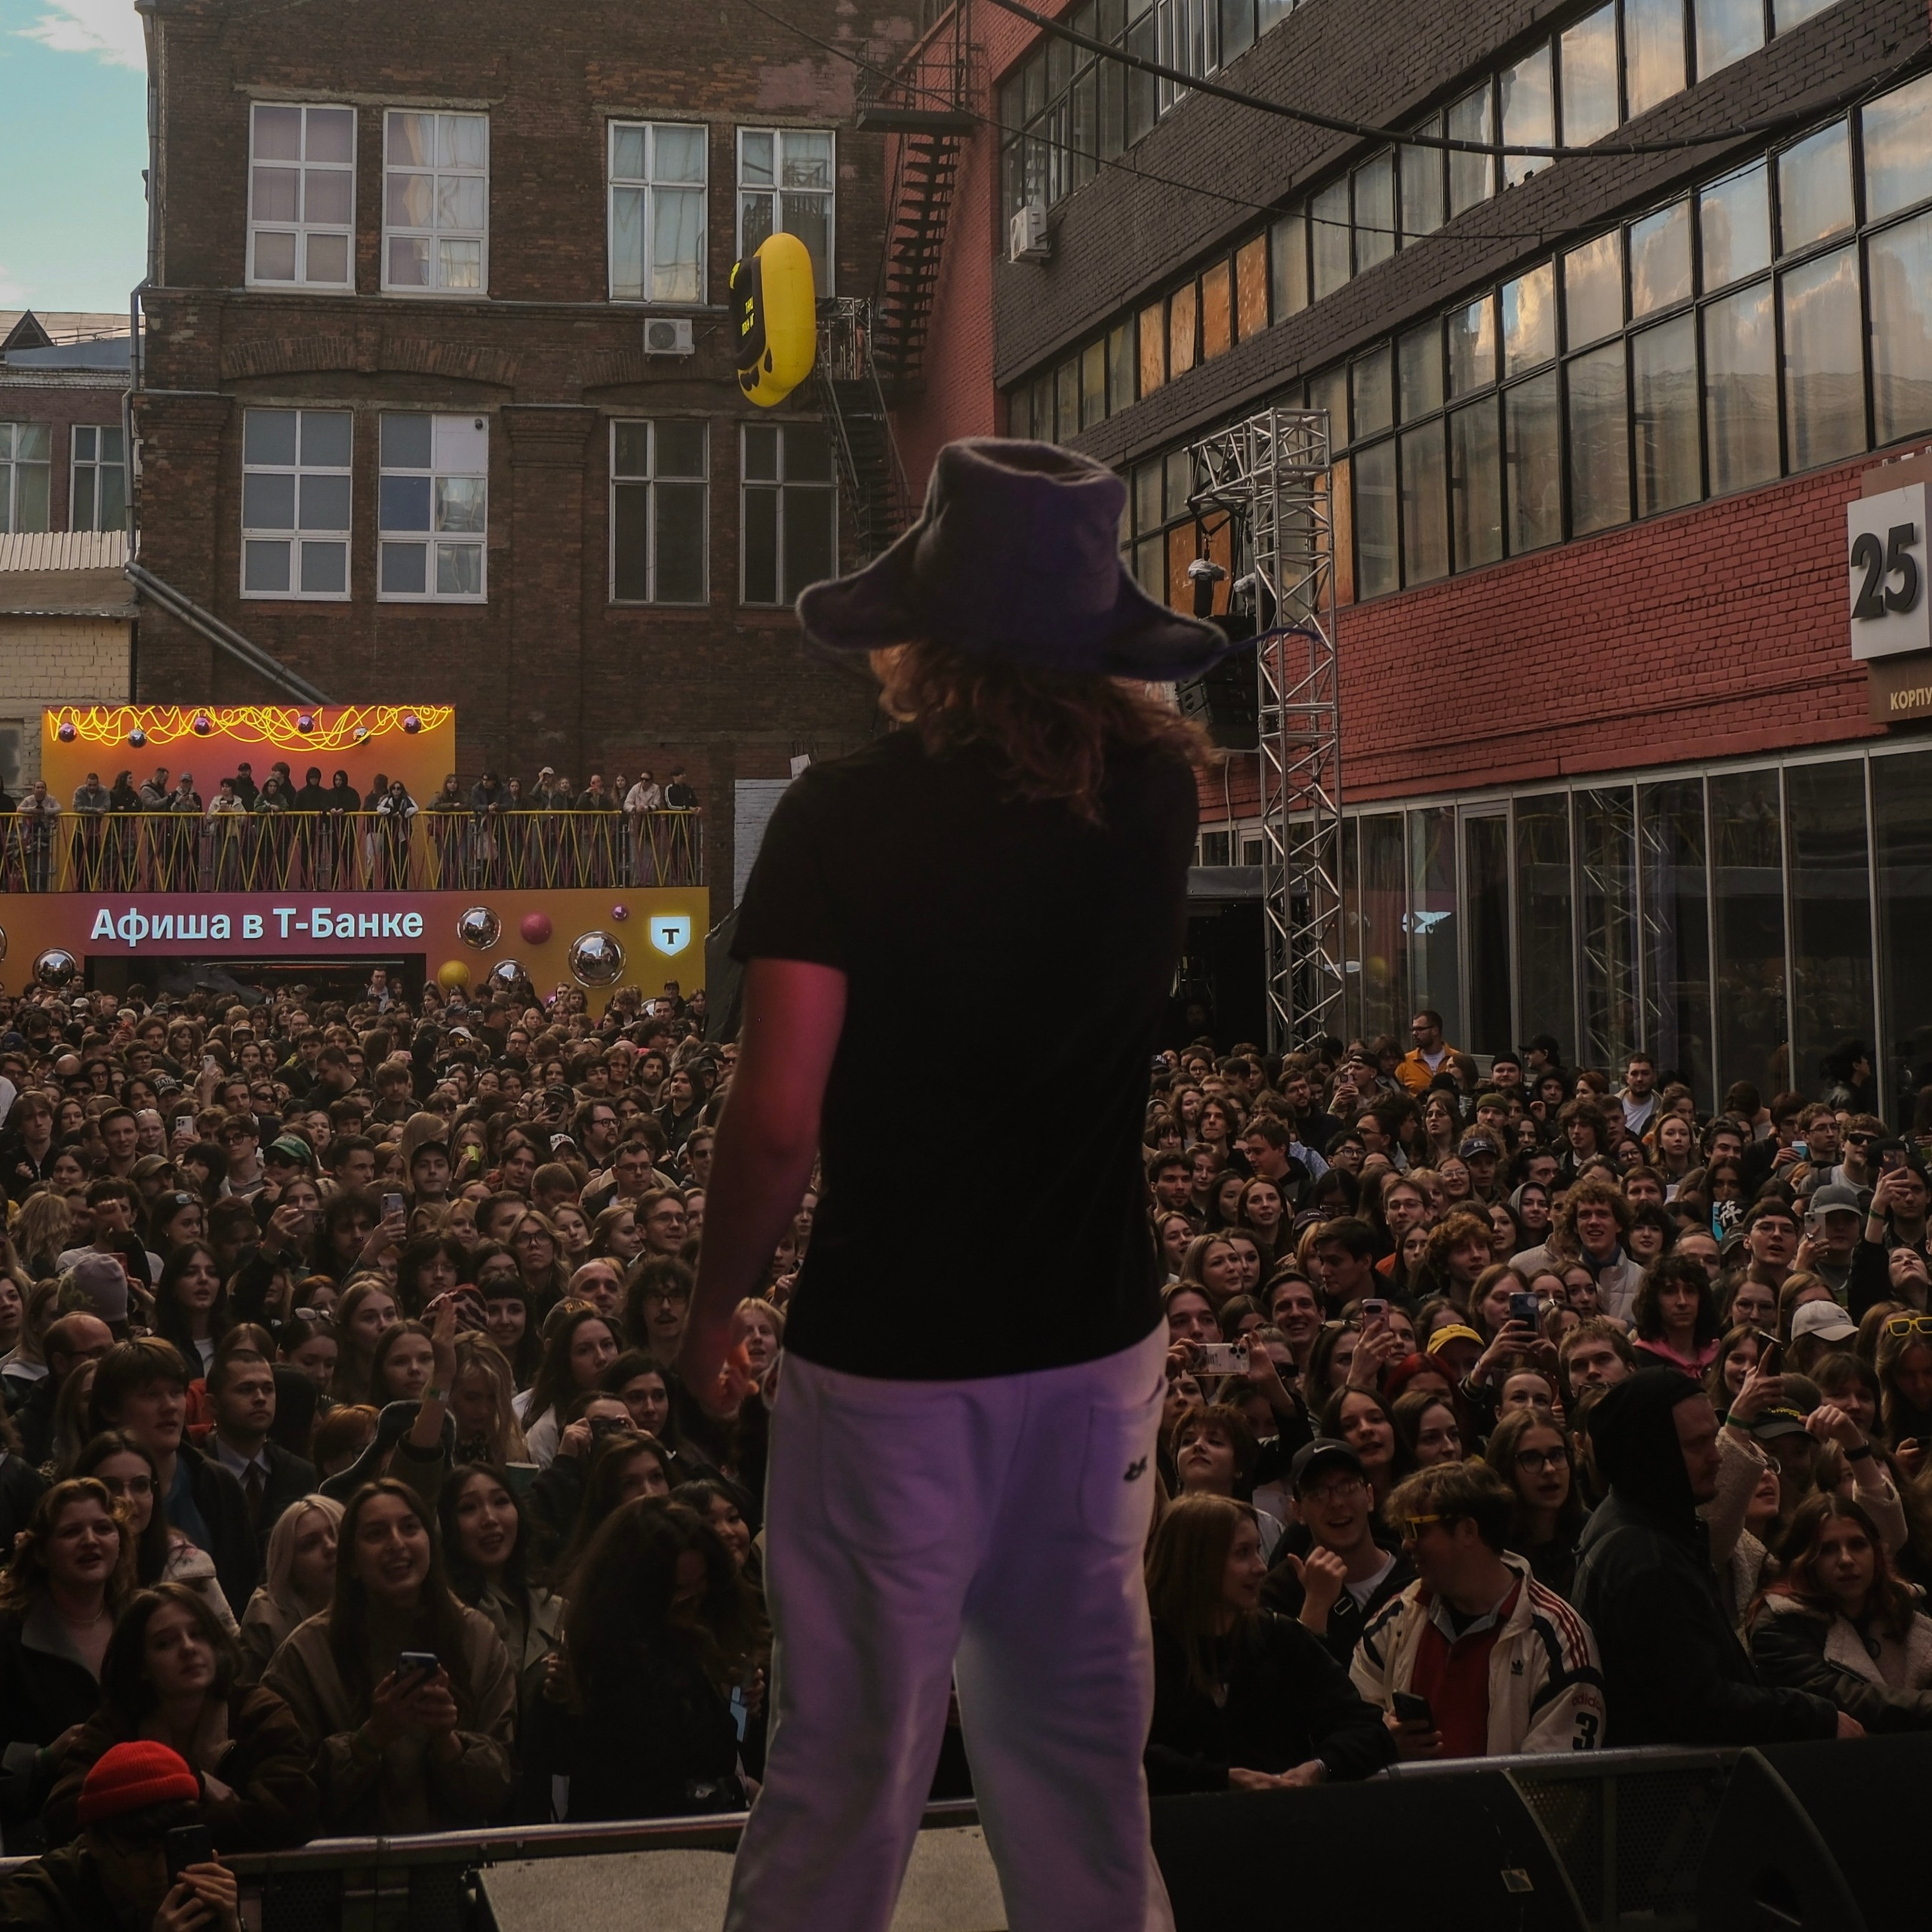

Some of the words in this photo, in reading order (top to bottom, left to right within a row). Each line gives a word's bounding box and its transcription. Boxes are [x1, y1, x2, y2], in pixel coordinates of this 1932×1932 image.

[1850, 522, 1918, 619] 25
[1890, 687, 1932, 710] КОРПУ
[90, 907, 231, 948] Афиша
[242, 914, 264, 939] в
[272, 907, 423, 939] Т-Банке
[1572, 1692, 1603, 1713] adida
[1572, 1711, 1598, 1749] 3
